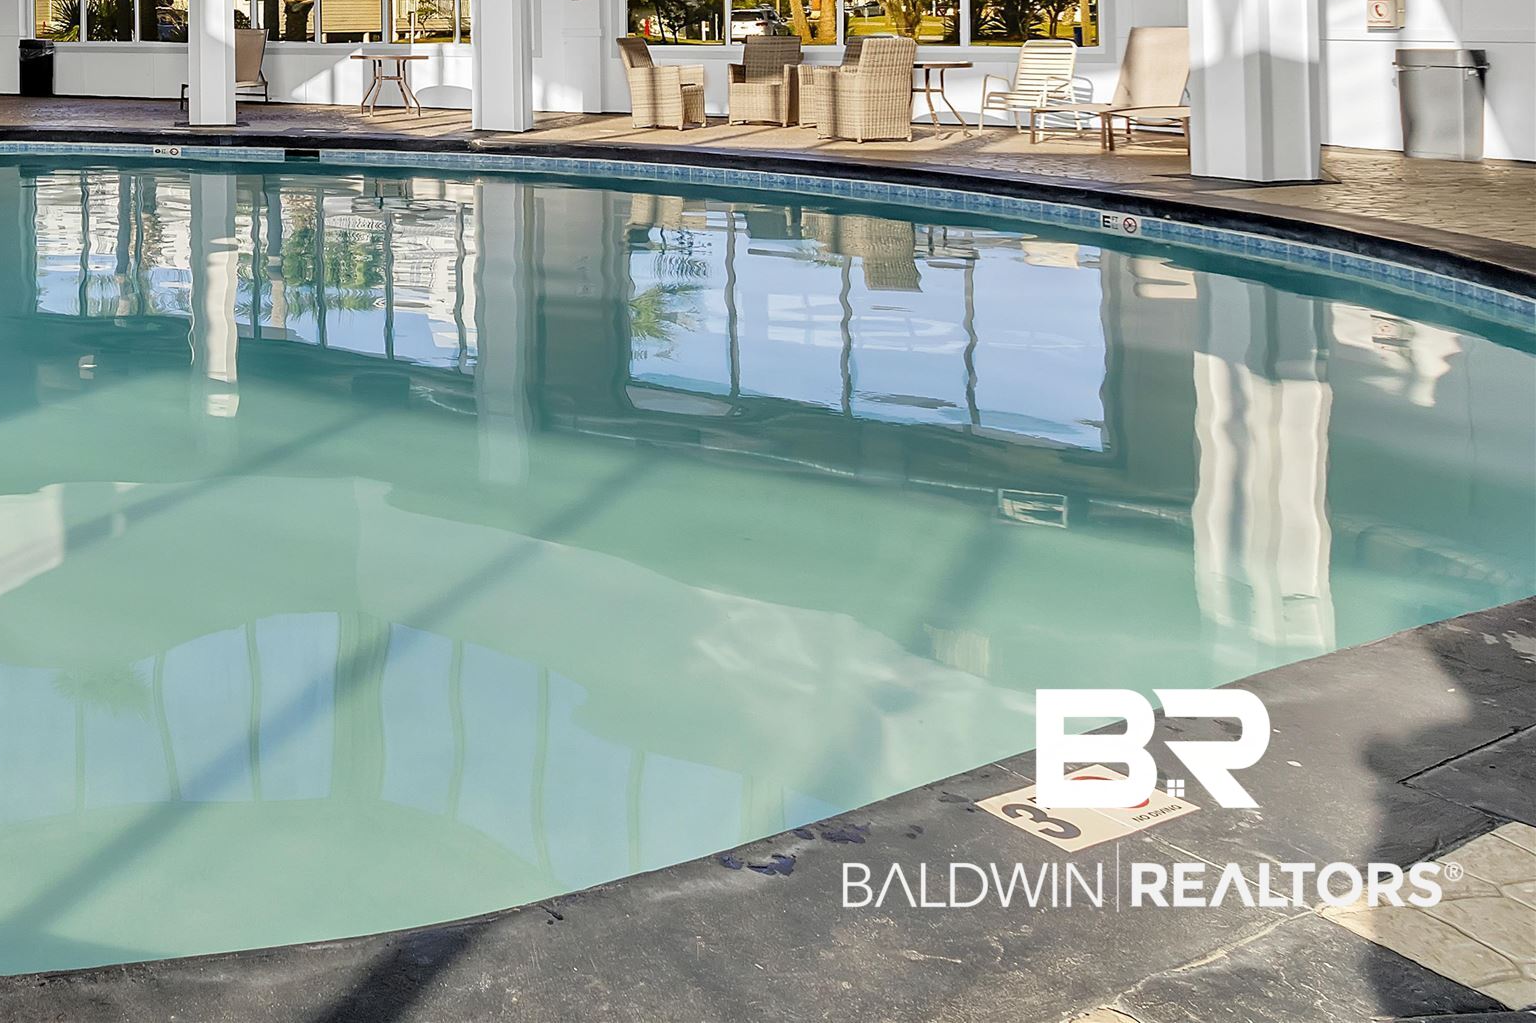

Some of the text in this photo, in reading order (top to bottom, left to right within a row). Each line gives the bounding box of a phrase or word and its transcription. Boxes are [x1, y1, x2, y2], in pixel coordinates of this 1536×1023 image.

[1001, 803, 1082, 840] 3
[1132, 804, 1182, 823] NO DIVING
